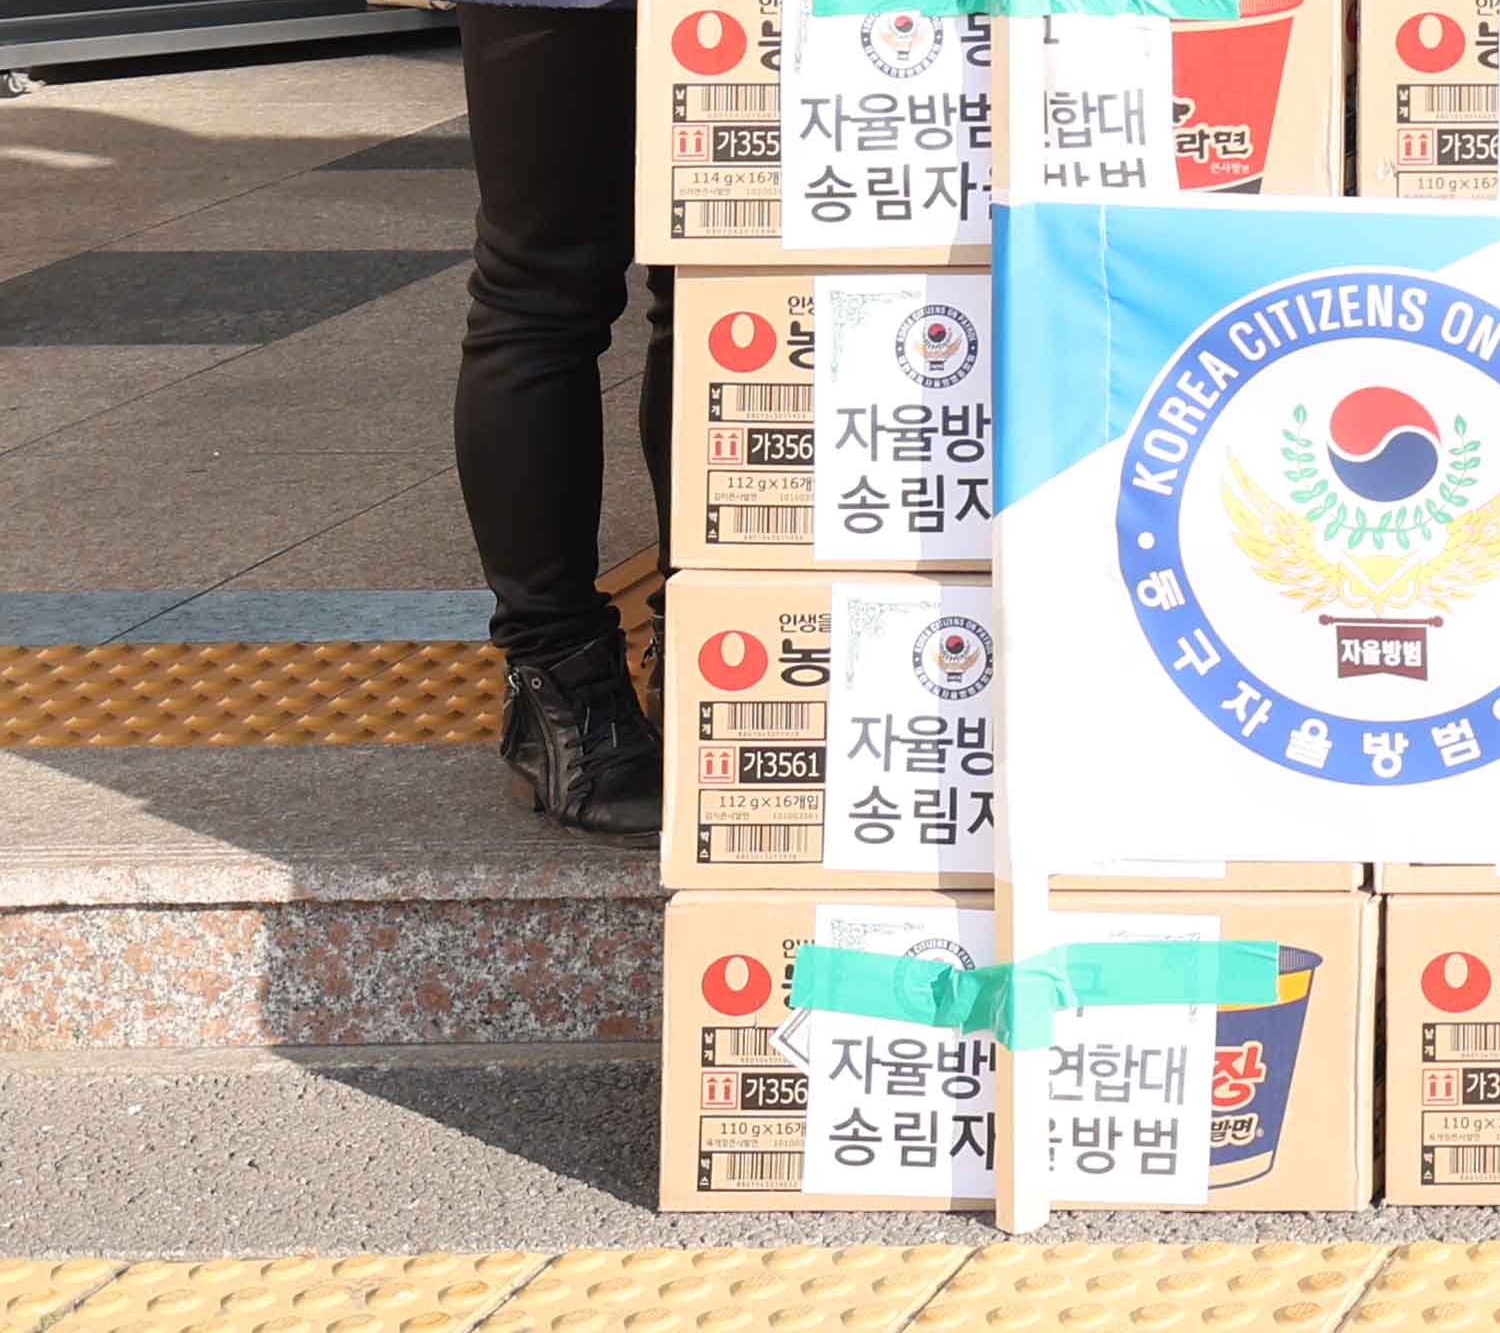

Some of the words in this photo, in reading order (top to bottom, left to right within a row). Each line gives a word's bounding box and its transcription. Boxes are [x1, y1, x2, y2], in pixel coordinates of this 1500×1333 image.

[1132, 349, 1238, 498] KOREA
[1227, 283, 1427, 364] CITIZENS
[1341, 639, 1422, 667] 자율방범
[743, 751, 820, 779] 가3561
